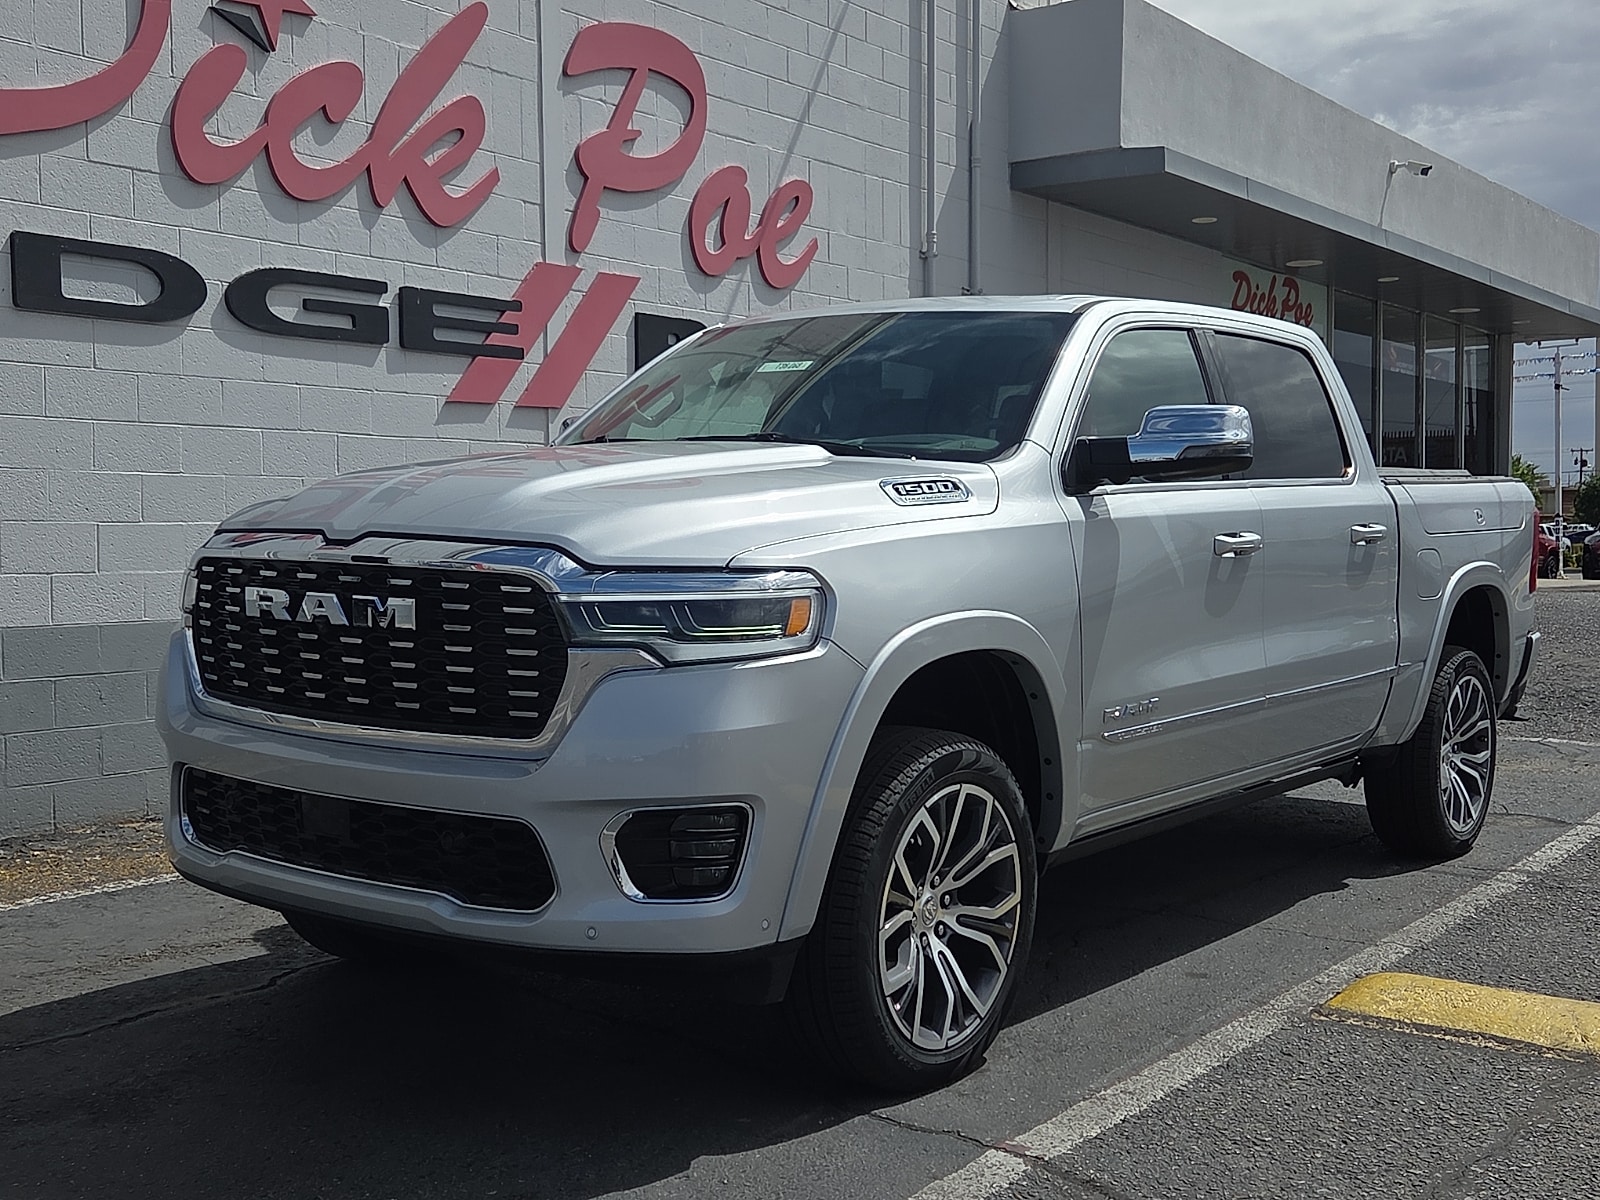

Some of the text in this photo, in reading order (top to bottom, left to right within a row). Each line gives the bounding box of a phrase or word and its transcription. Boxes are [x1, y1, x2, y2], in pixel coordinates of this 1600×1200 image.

[563, 21, 818, 290] Poe
[1232, 270, 1314, 328] Dick Poe
[893, 481, 955, 496] 1500
[245, 586, 416, 631] RAM
